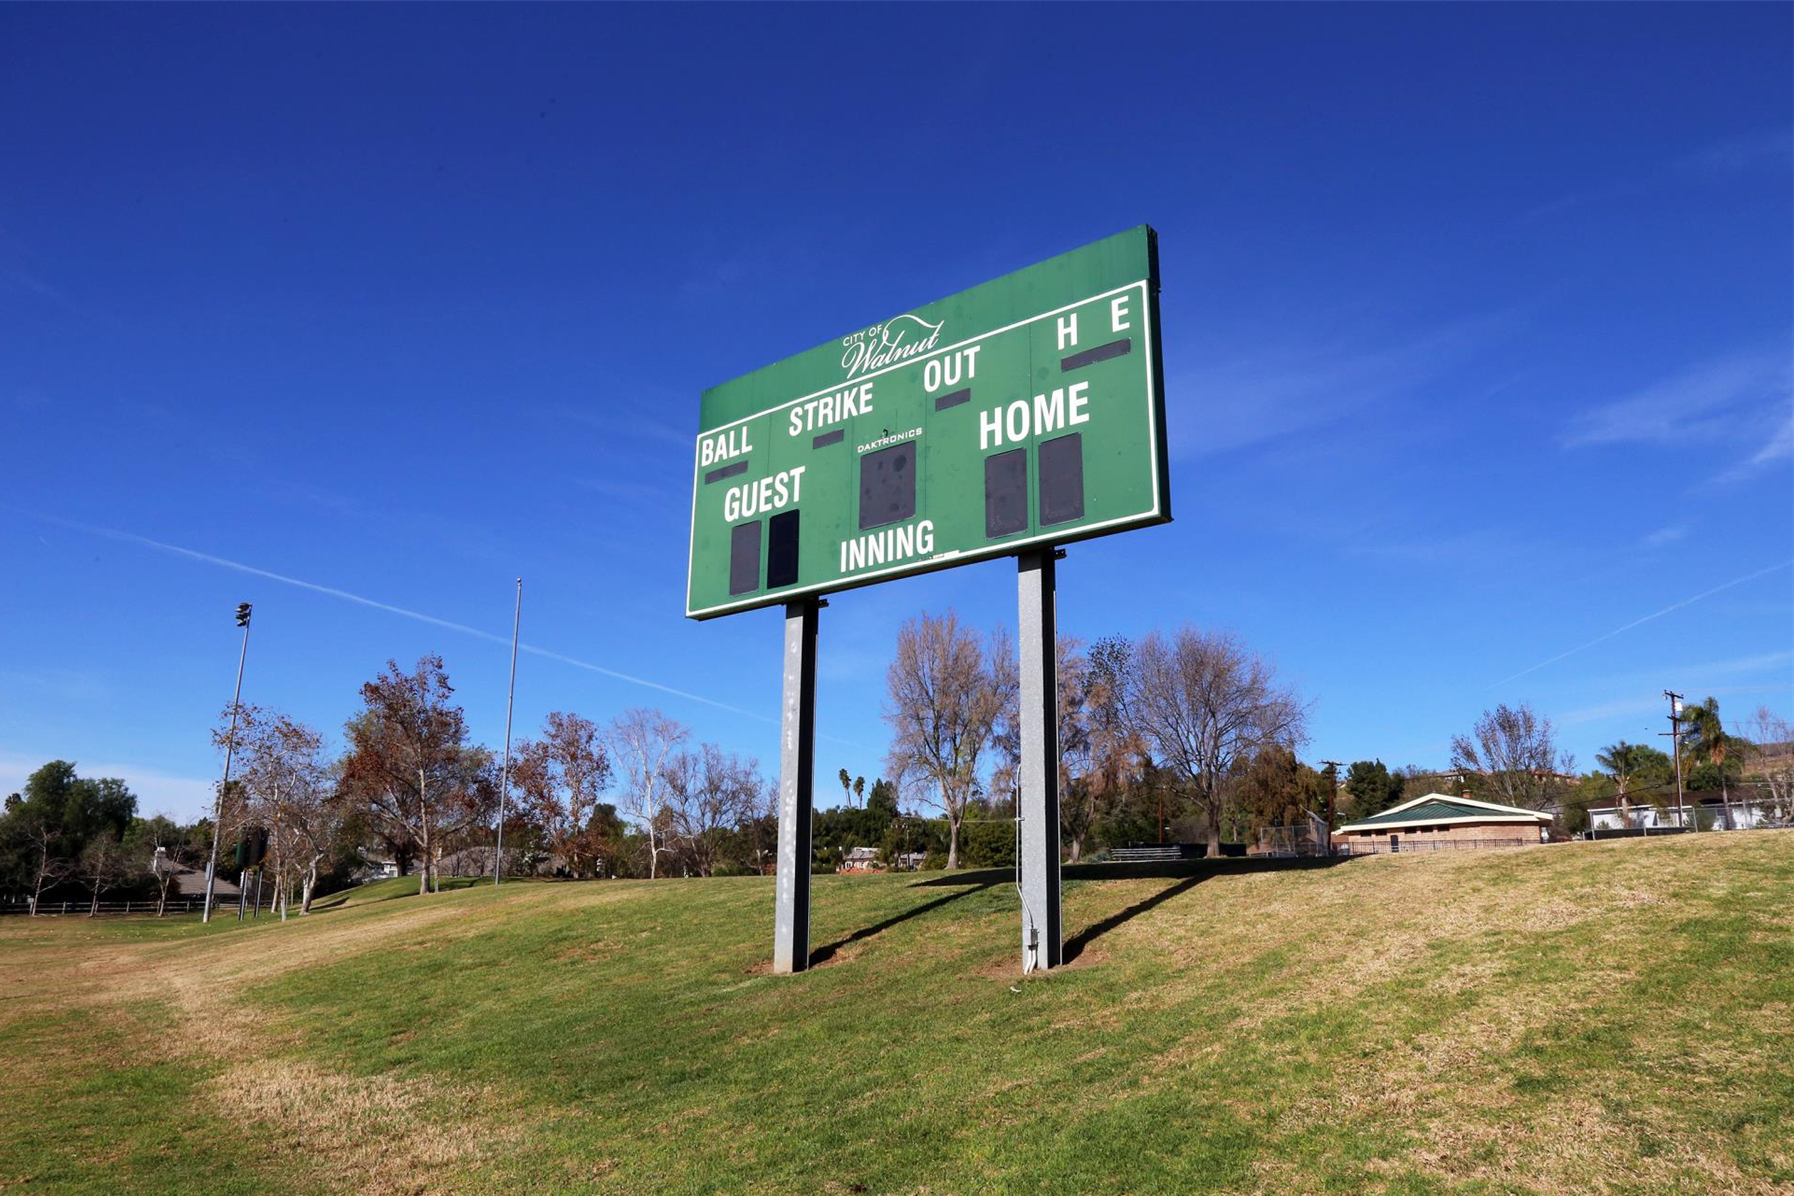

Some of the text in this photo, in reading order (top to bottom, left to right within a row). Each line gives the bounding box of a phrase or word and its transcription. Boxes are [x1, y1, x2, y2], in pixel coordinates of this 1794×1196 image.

[841, 314, 945, 380] Walnut
[842, 324, 883, 347] CITY OF
[1056, 294, 1131, 351] H E
[923, 344, 981, 393] OUT
[788, 381, 874, 437] STRIKE
[979, 380, 1090, 451] HOME
[700, 425, 753, 468] BALL
[857, 427, 923, 454] DAKTRONICS
[723, 465, 806, 523] GUEST
[840, 519, 934, 573] INNING
